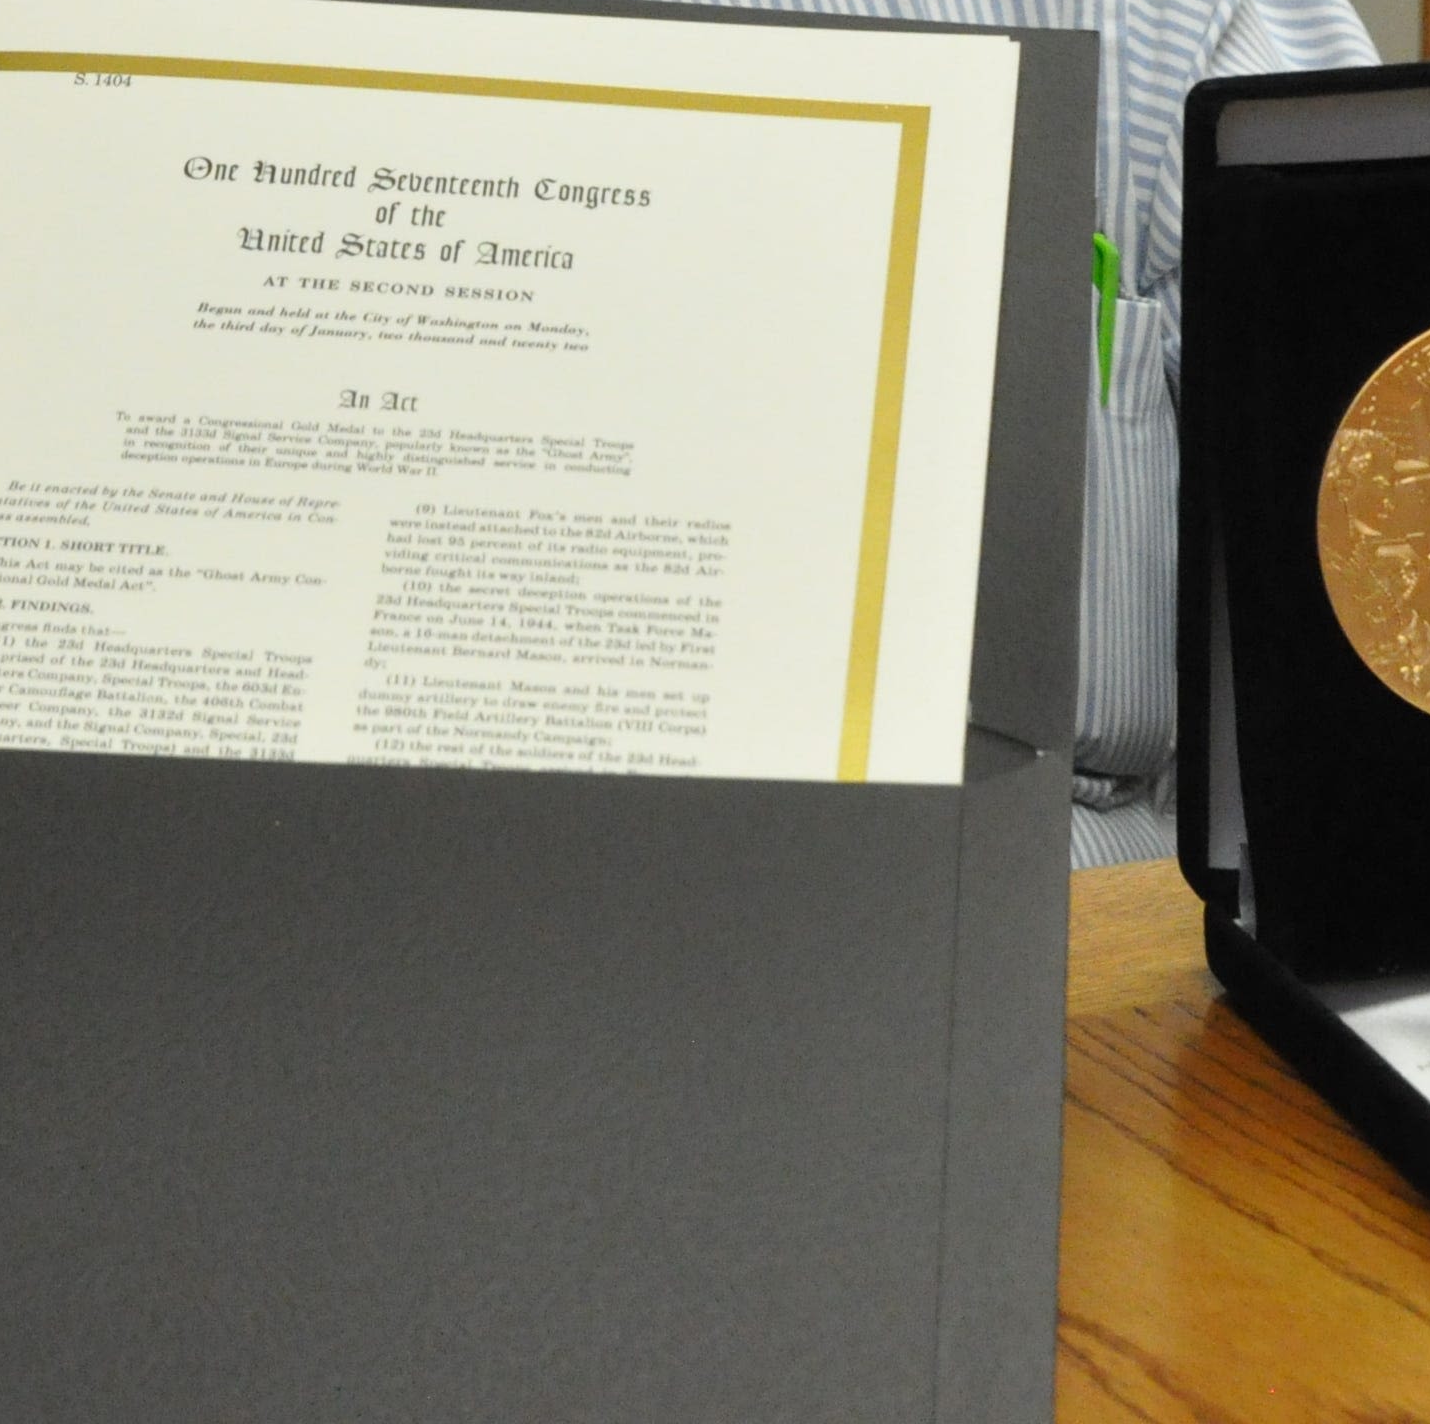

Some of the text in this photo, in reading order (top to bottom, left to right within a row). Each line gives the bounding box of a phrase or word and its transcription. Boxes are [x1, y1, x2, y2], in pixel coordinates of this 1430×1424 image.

[74, 71, 132, 87] S. 1404
[183, 156, 650, 210] One Hundred Seventeenth Congress
[374, 201, 446, 228] of the
[239, 226, 574, 270] United States of America
[263, 275, 534, 302] AT THE SECOND SESSION
[196, 301, 242, 316] Begun
[247, 305, 276, 317] and
[278, 306, 312, 319] held
[314, 311, 330, 320] at
[334, 310, 357, 322] the
[362, 312, 390, 326] City
[395, 313, 414, 327] of
[416, 314, 499, 331] Washington
[503, 323, 522, 331] on
[192, 317, 215, 329] the
[220, 319, 256, 332] third
[258, 322, 285, 336] day
[290, 324, 309, 337] of
[377, 330, 403, 340] two
[407, 330, 475, 345] thousand
[478, 335, 508, 347] and
[511, 339, 557, 351] twenty
[562, 341, 589, 352] two
[339, 389, 418, 413] An Act
[14, 513, 90, 527] assembled,
[59, 540, 115, 553] SHORT
[118, 543, 168, 557] TITLE.
[10, 599, 94, 614] FINDINGS.
